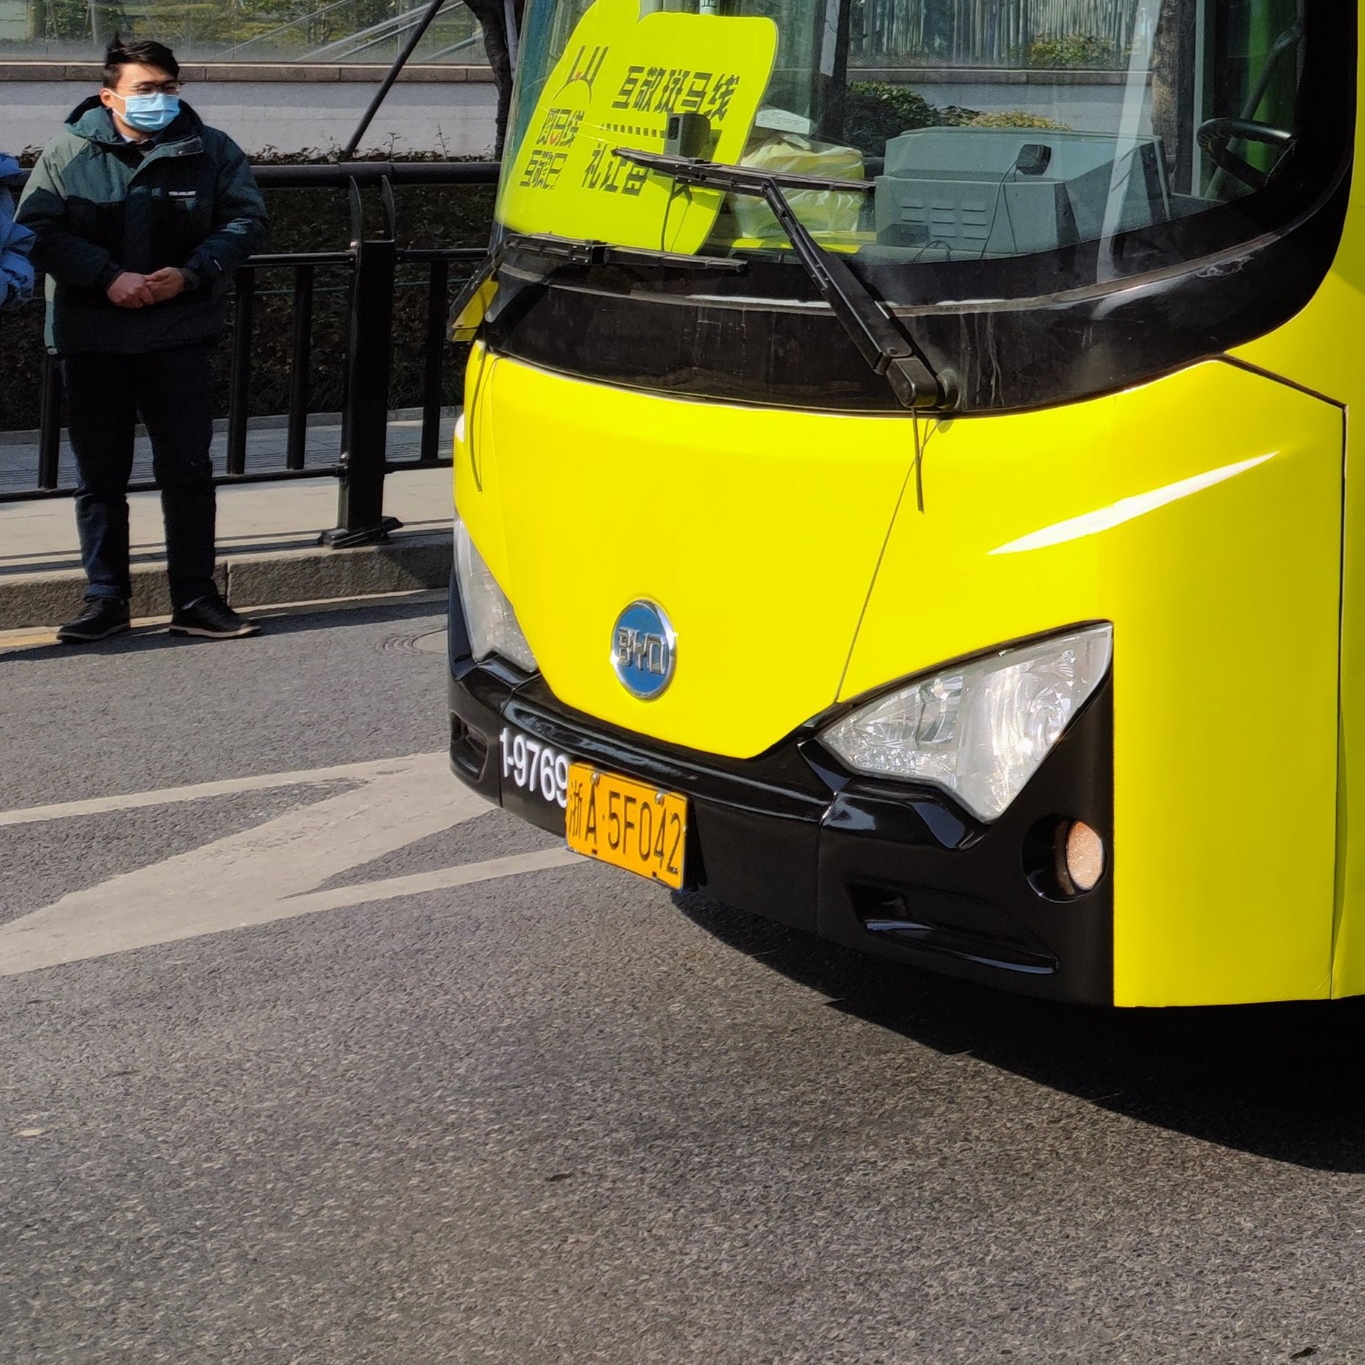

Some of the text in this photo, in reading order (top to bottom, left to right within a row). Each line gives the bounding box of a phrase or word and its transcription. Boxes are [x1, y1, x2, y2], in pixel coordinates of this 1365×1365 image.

[611, 65, 741, 122] 互敬斑马线
[618, 626, 668, 675] BYD
[500, 727, 569, 809] 1-9769
